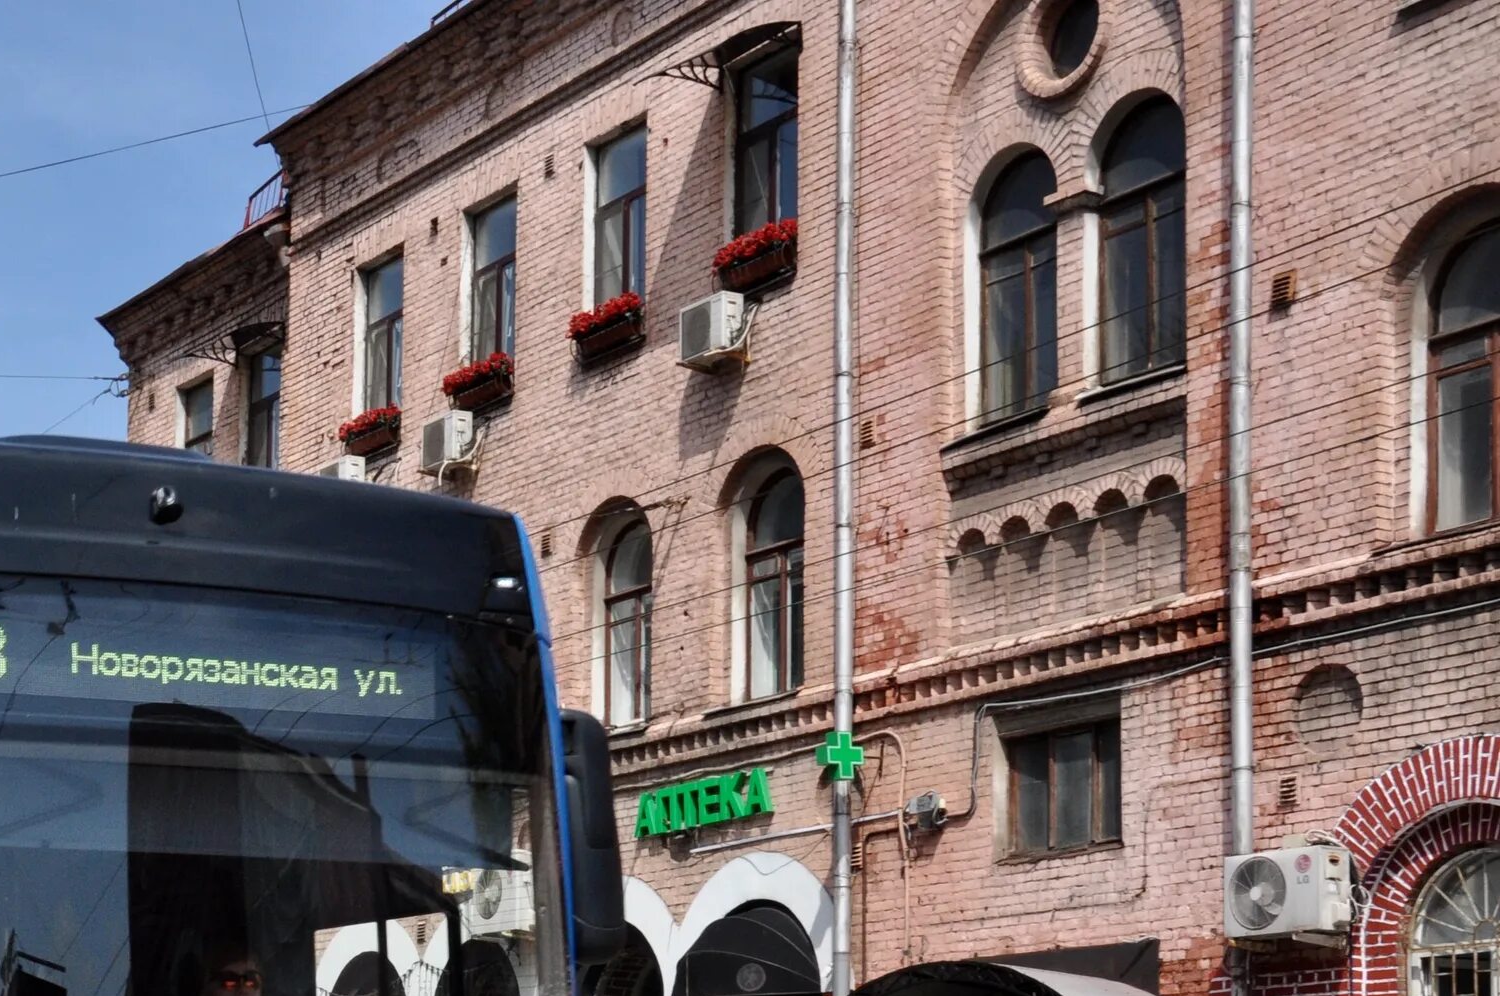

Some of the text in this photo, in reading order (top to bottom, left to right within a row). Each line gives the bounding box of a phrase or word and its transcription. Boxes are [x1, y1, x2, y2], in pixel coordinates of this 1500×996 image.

[71, 641, 338, 692] Новорязанская
[353, 665, 403, 697] ул.
[634, 766, 775, 838] АПТЕКА
[1296, 875, 1310, 885] LG
